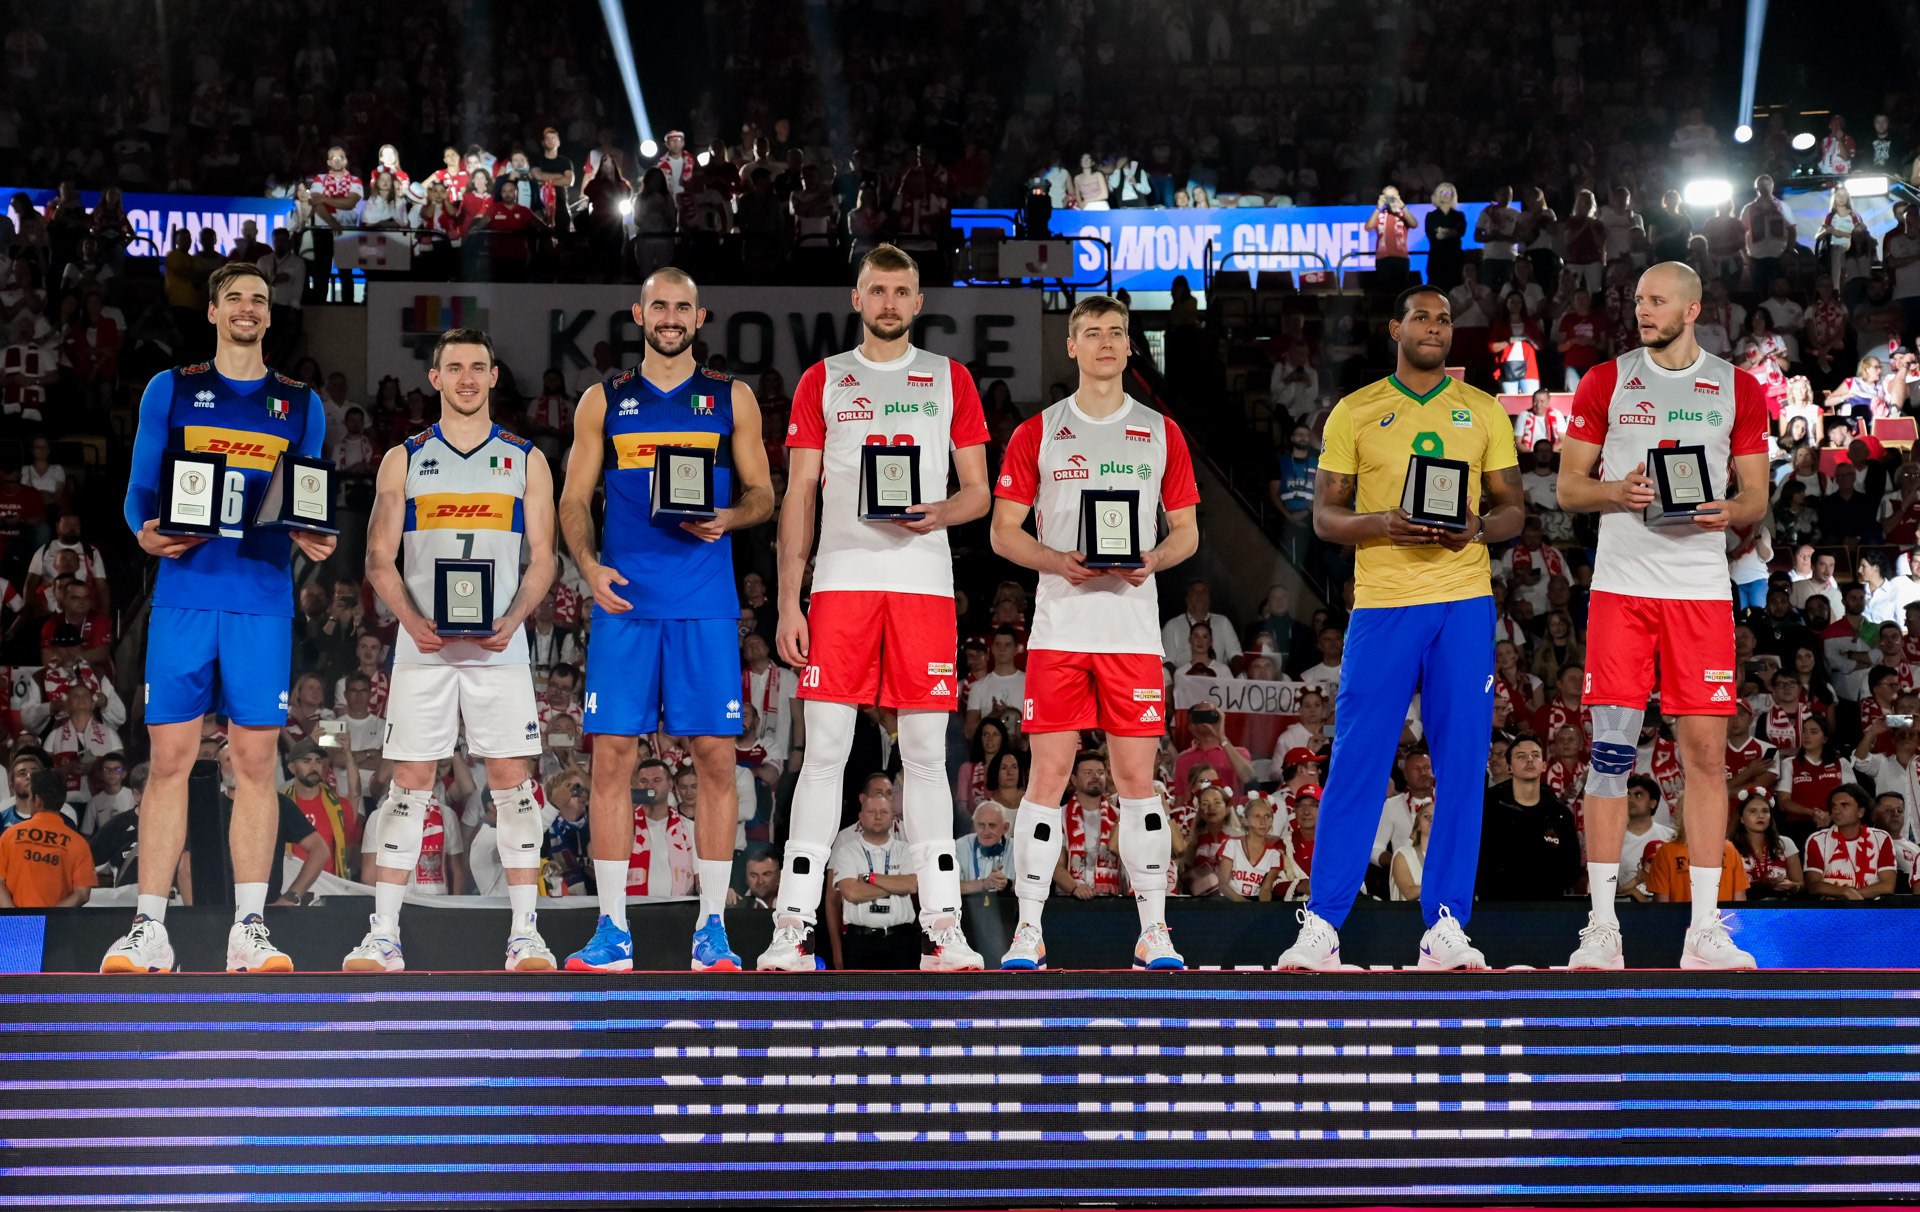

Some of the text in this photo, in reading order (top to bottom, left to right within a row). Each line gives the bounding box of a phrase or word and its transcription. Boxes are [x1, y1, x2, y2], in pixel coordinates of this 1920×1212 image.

[1079, 221, 1377, 272] SIMONE GIANNEL
[1026, 244, 1047, 273] J
[549, 308, 1015, 378] KAOWCE
[838, 380, 860, 388] adidas
[1693, 387, 1720, 396] POLSKA
[268, 409, 287, 421] ITA
[693, 407, 713, 416] ITA
[838, 411, 872, 421] ORLEN
[885, 402, 919, 416] plus
[1668, 408, 1703, 422] plus
[1620, 415, 1654, 425] ORLEN
[1054, 433, 1076, 441] adidas
[1125, 435, 1151, 443] POLSKA
[207, 438, 266, 458] DHL
[492, 468, 511, 477] ITA
[1054, 469, 1088, 480] ORLEN
[1101, 461, 1134, 476] plus
[221, 470, 246, 525] 6
[436, 504, 493, 518] DHL
[456, 533, 475, 560] 7
[802, 665, 820, 688] 20
[584, 691, 598, 714] 14
[1023, 698, 1034, 721] 16
[15, 828, 72, 847] FORT
[24, 849, 60, 866] 3048
[1231, 869, 1264, 885] POLSK
